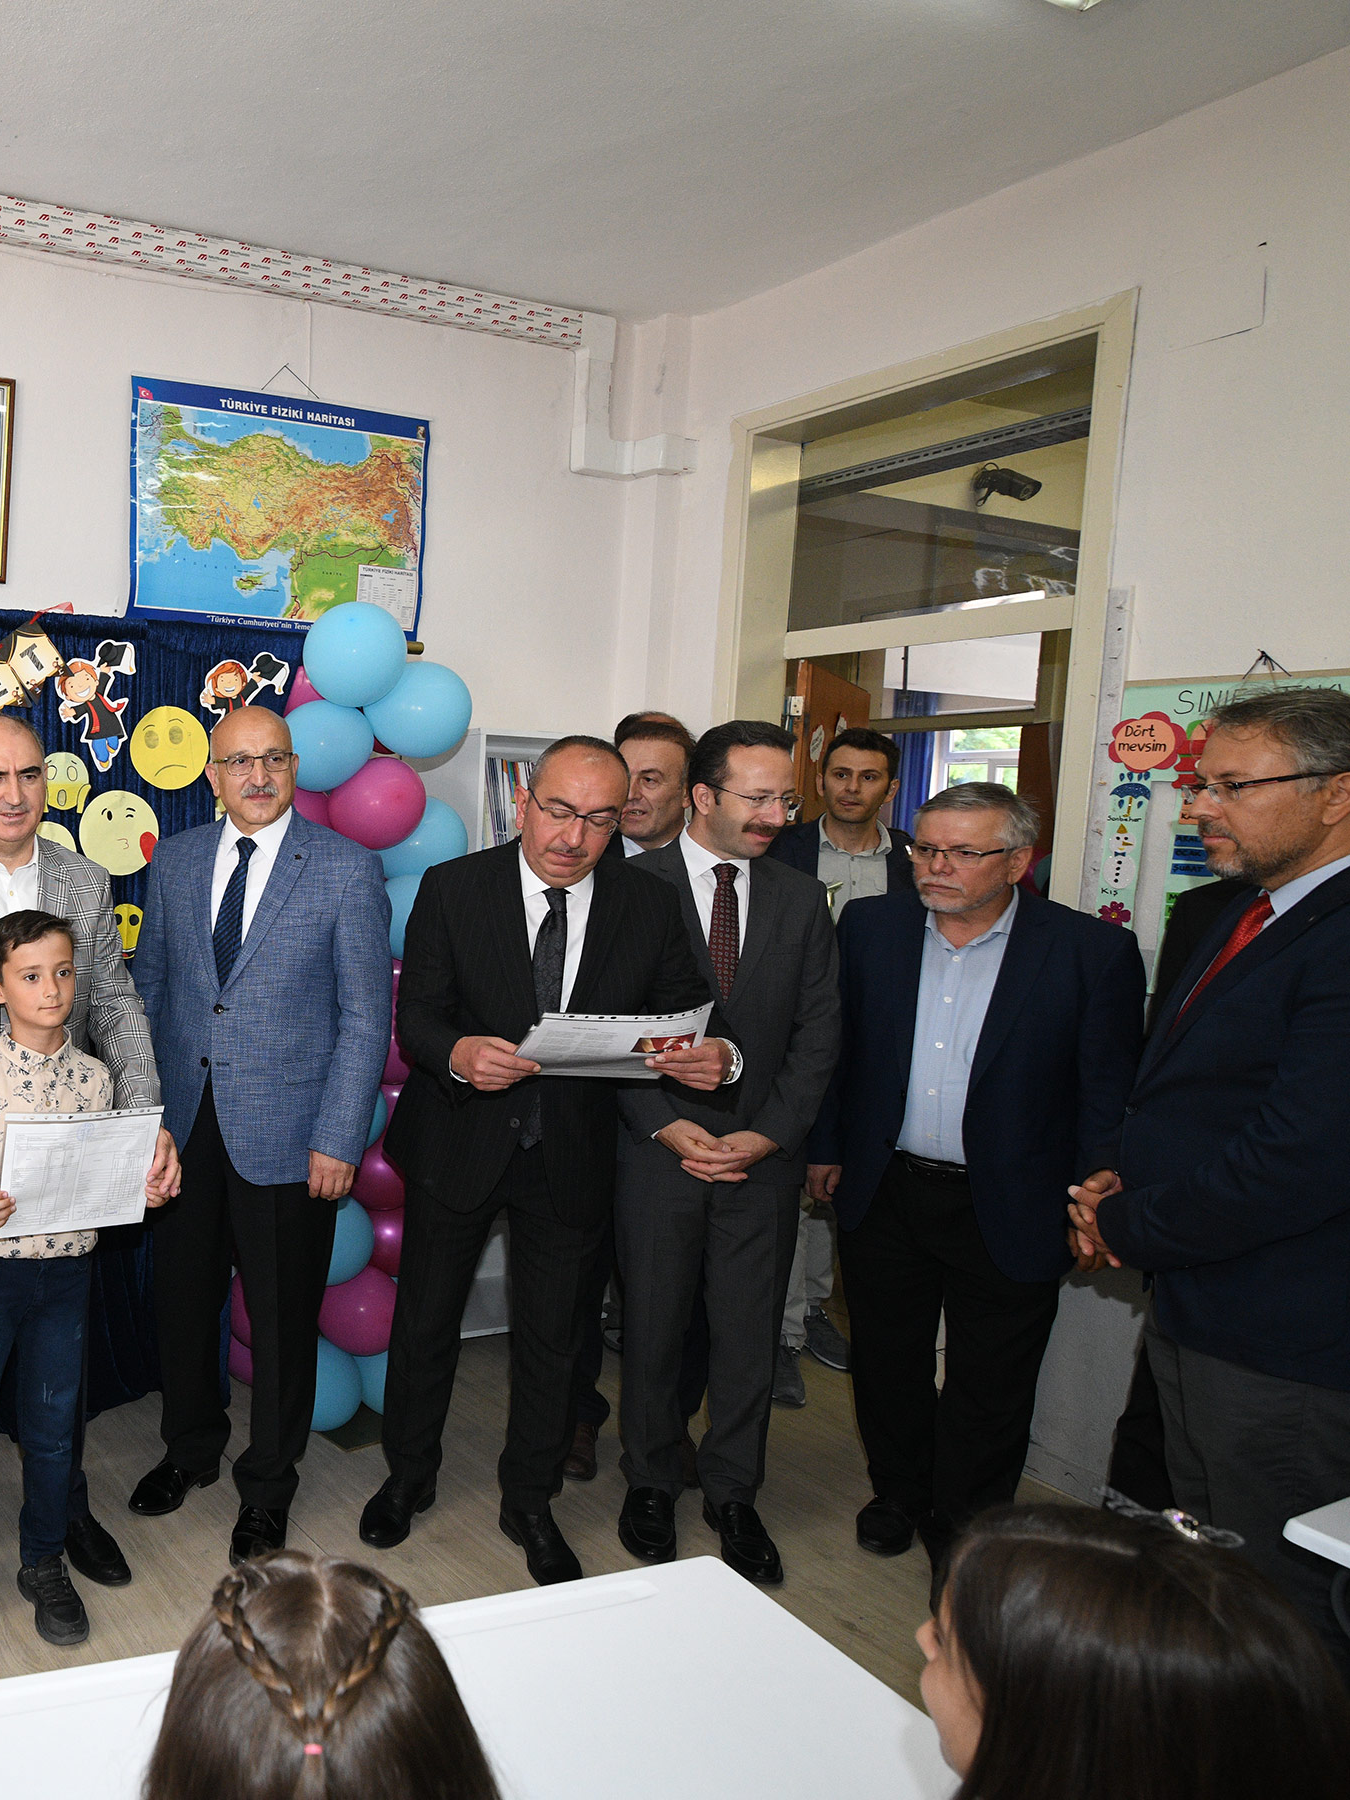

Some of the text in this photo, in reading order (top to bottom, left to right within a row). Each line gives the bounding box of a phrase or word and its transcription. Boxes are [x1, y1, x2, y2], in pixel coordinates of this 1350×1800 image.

[219, 398, 355, 427] TÜRKİYE FİZİKİ HARİTASI
[294, 622, 313, 630] Teme
[1124, 724, 1155, 738] Dört
[1118, 739, 1167, 752] mevsim
